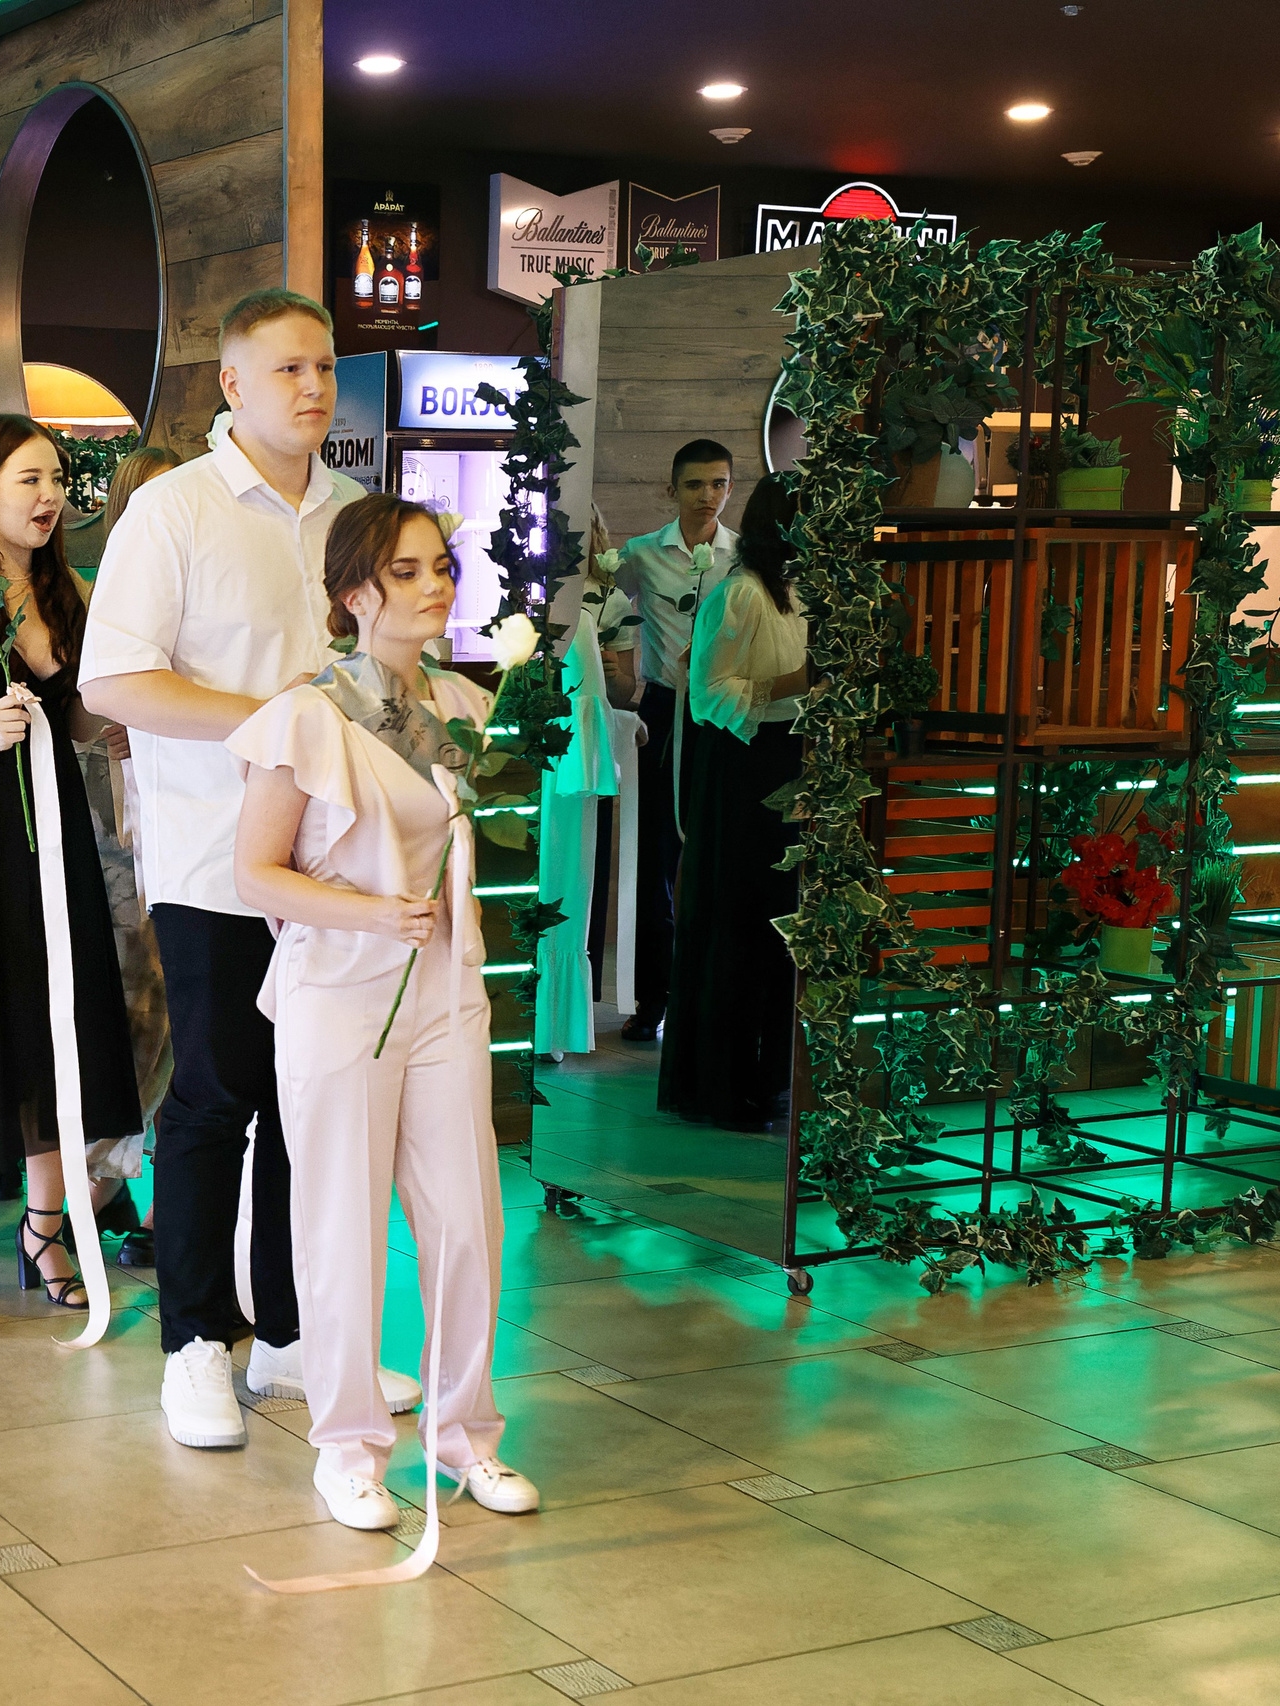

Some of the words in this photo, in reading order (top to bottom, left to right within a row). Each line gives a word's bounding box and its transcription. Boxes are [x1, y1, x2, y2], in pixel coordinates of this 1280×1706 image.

[512, 207, 606, 245] Ballantine's
[640, 213, 709, 239] Ballantine's
[520, 254, 551, 274] TRUE
[420, 386, 521, 416] BORJO
